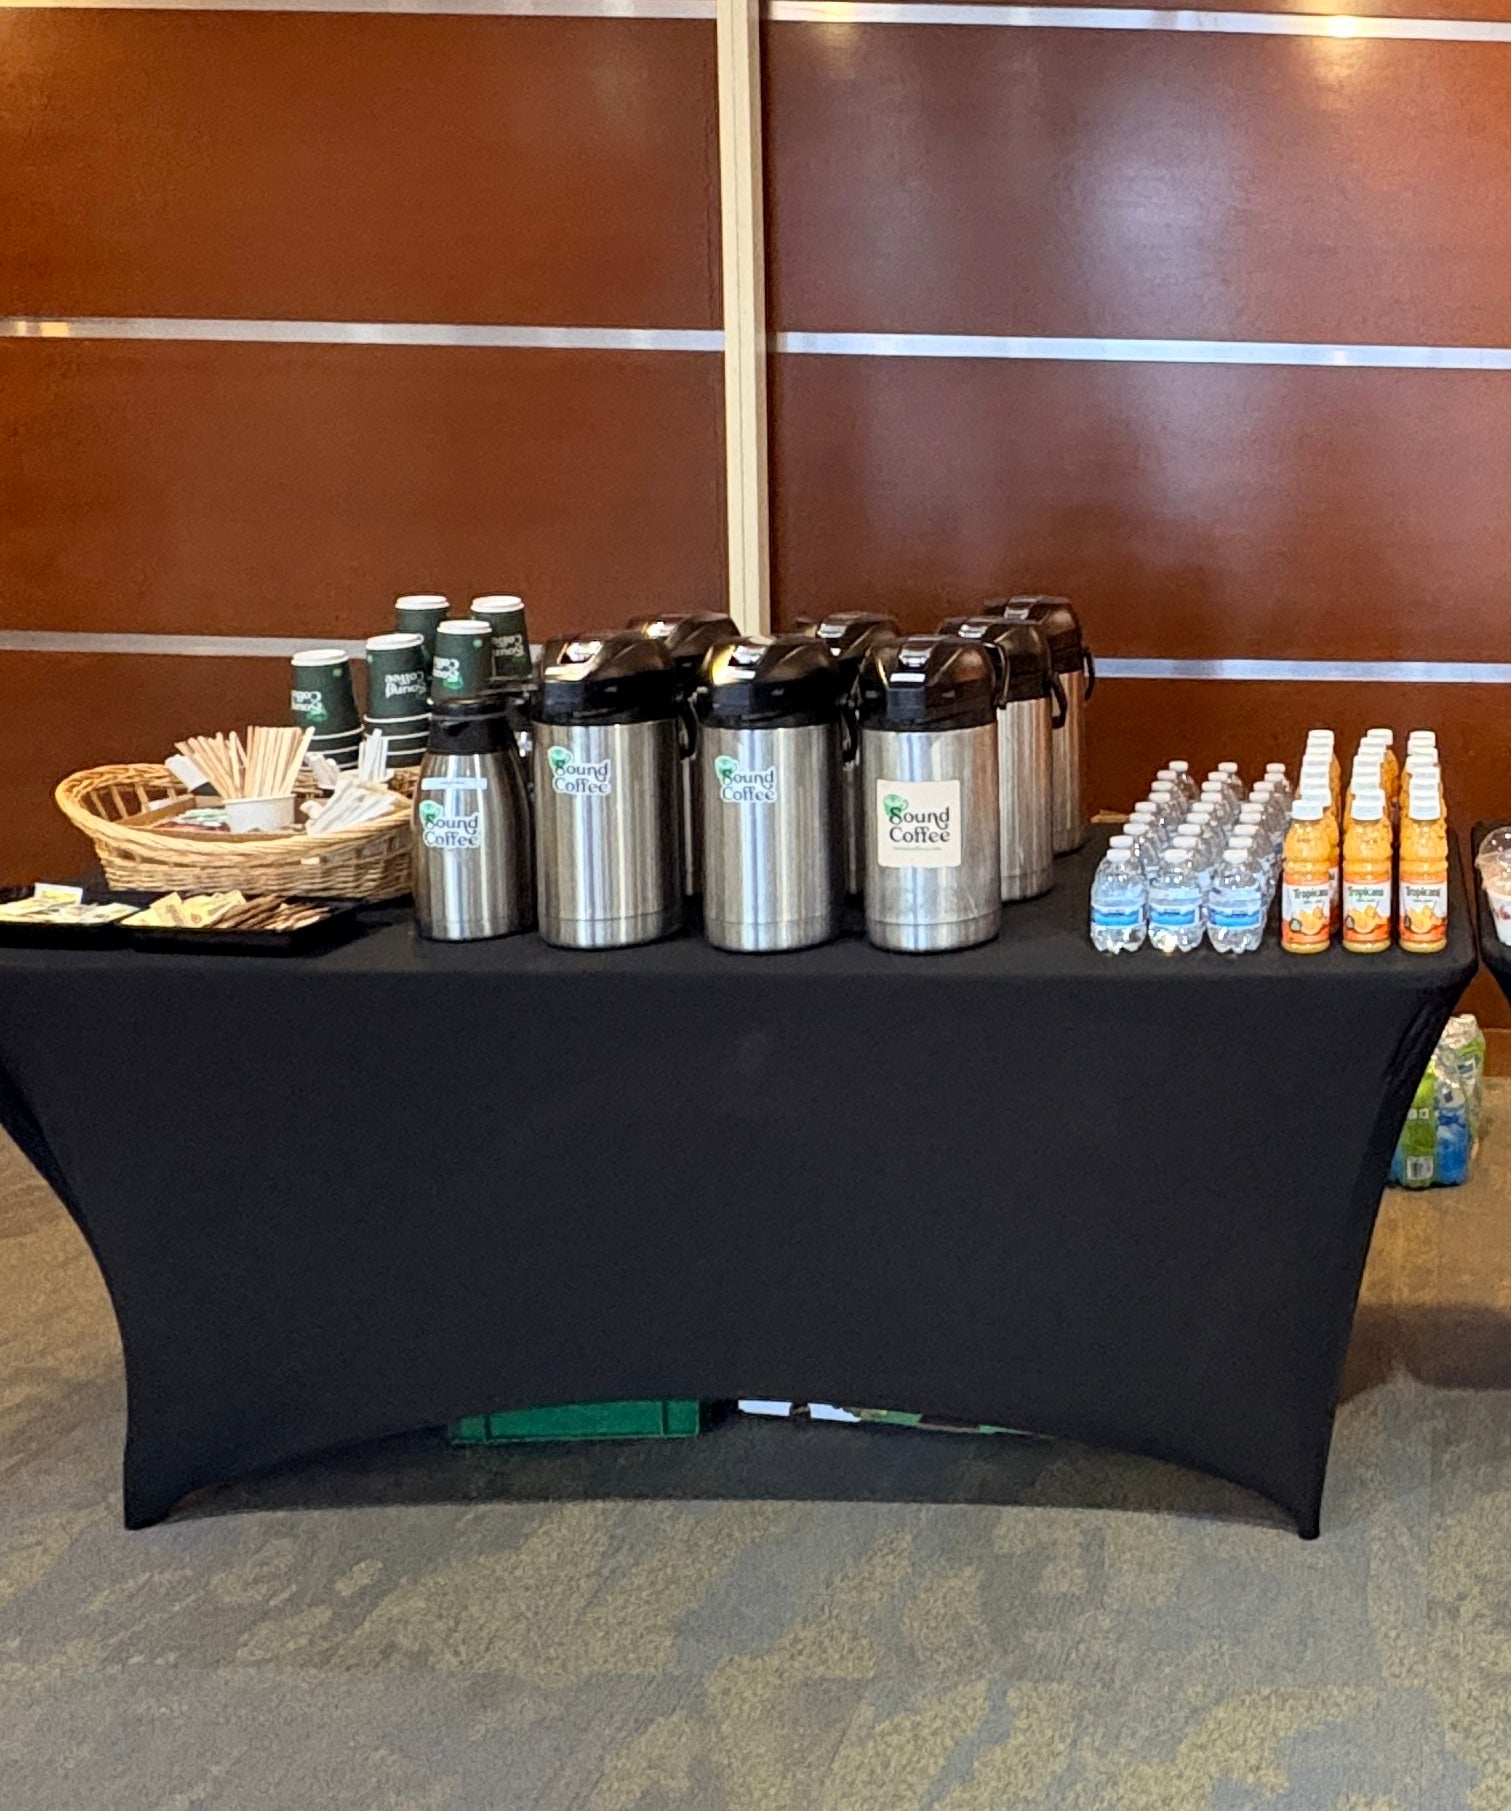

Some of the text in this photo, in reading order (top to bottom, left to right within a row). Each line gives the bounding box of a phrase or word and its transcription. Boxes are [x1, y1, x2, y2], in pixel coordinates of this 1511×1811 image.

[555, 760, 608, 782] Sound
[722, 769, 774, 789] Sound
[555, 777, 608, 793] Coffee
[722, 786, 775, 801] Coffee
[425, 814, 478, 835] Sound
[888, 806, 950, 830] Sound
[424, 831, 480, 846] Coffee
[889, 826, 951, 843] Coffee
